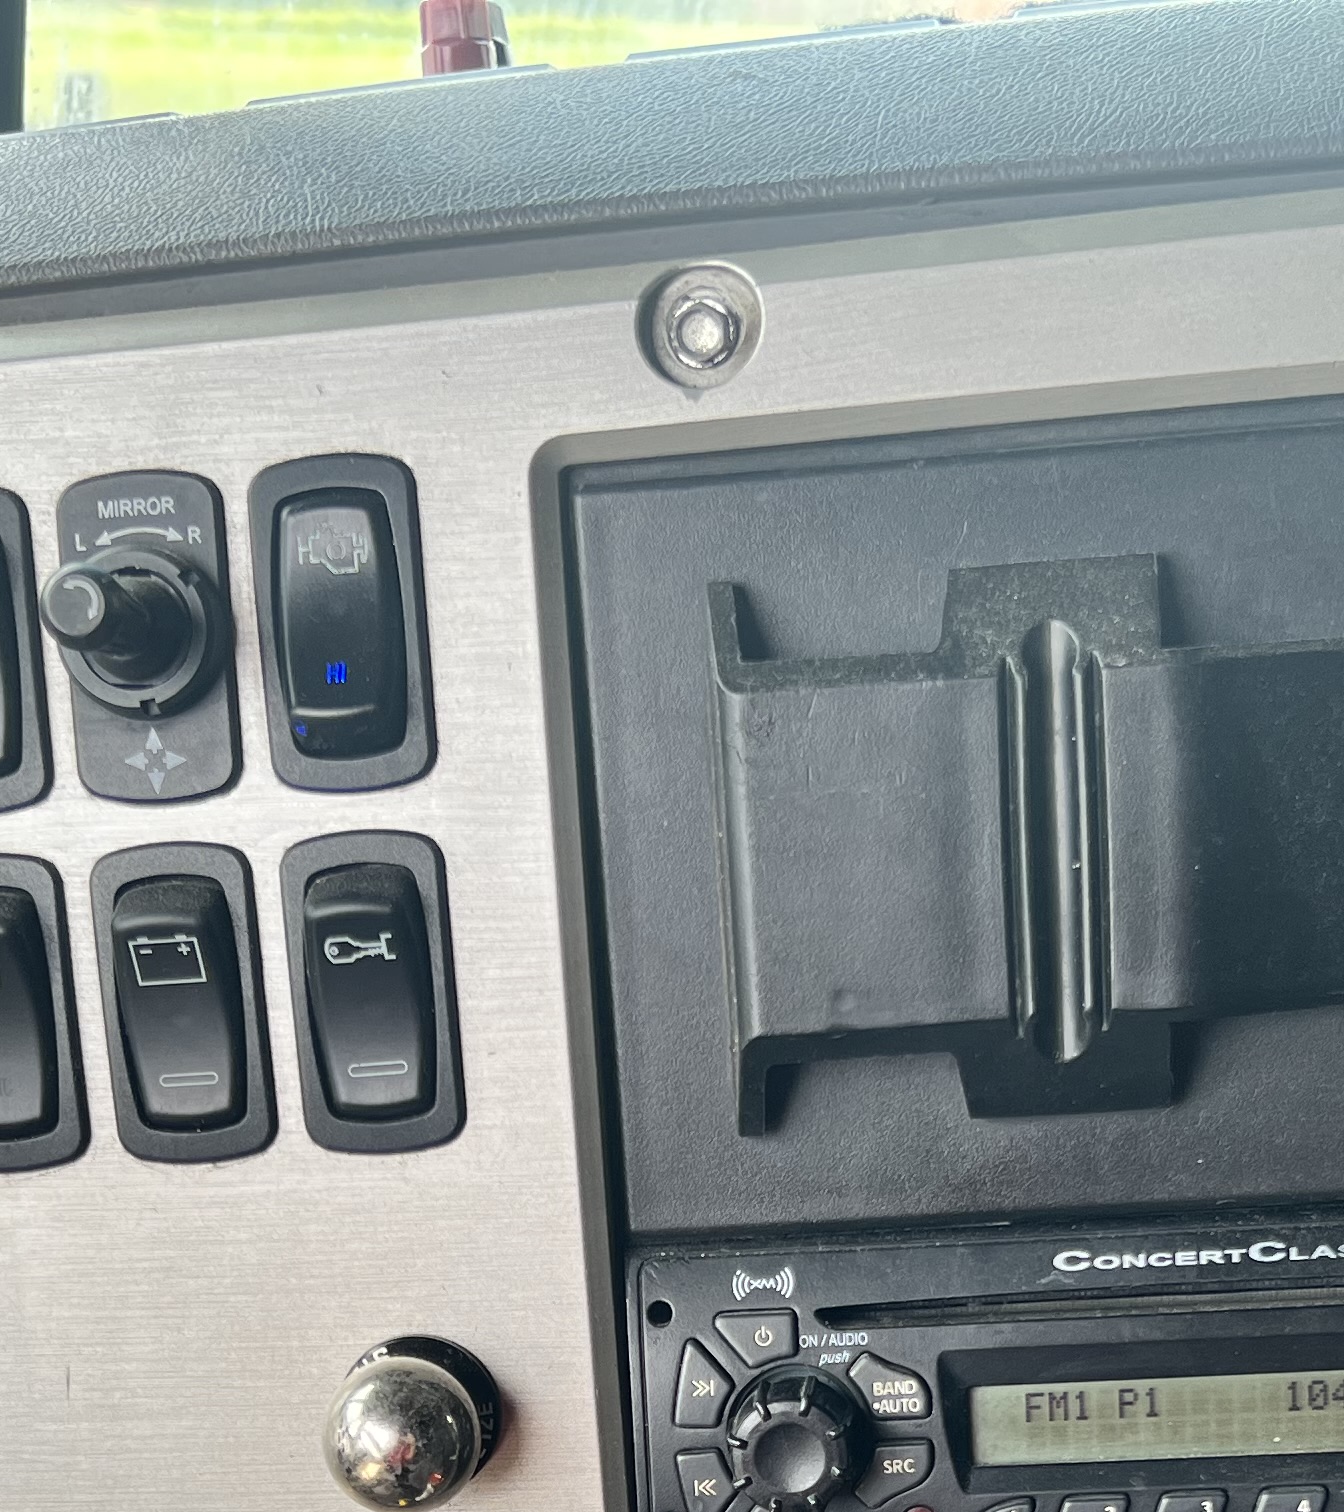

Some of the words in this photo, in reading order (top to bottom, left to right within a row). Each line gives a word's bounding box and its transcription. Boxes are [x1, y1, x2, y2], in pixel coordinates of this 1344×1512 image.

[96, 496, 176, 519] MIRROR
[74, 533, 87, 552] L
[187, 526, 202, 545] R
[799, 1333, 818, 1349] ON
[829, 1331, 869, 1347] AUDIO
[818, 1349, 851, 1368] push
[872, 1379, 917, 1397] BAND
[1025, 1391, 1088, 1424] FM1
[1119, 1387, 1160, 1419] P1
[882, 1457, 916, 1475] SRC
